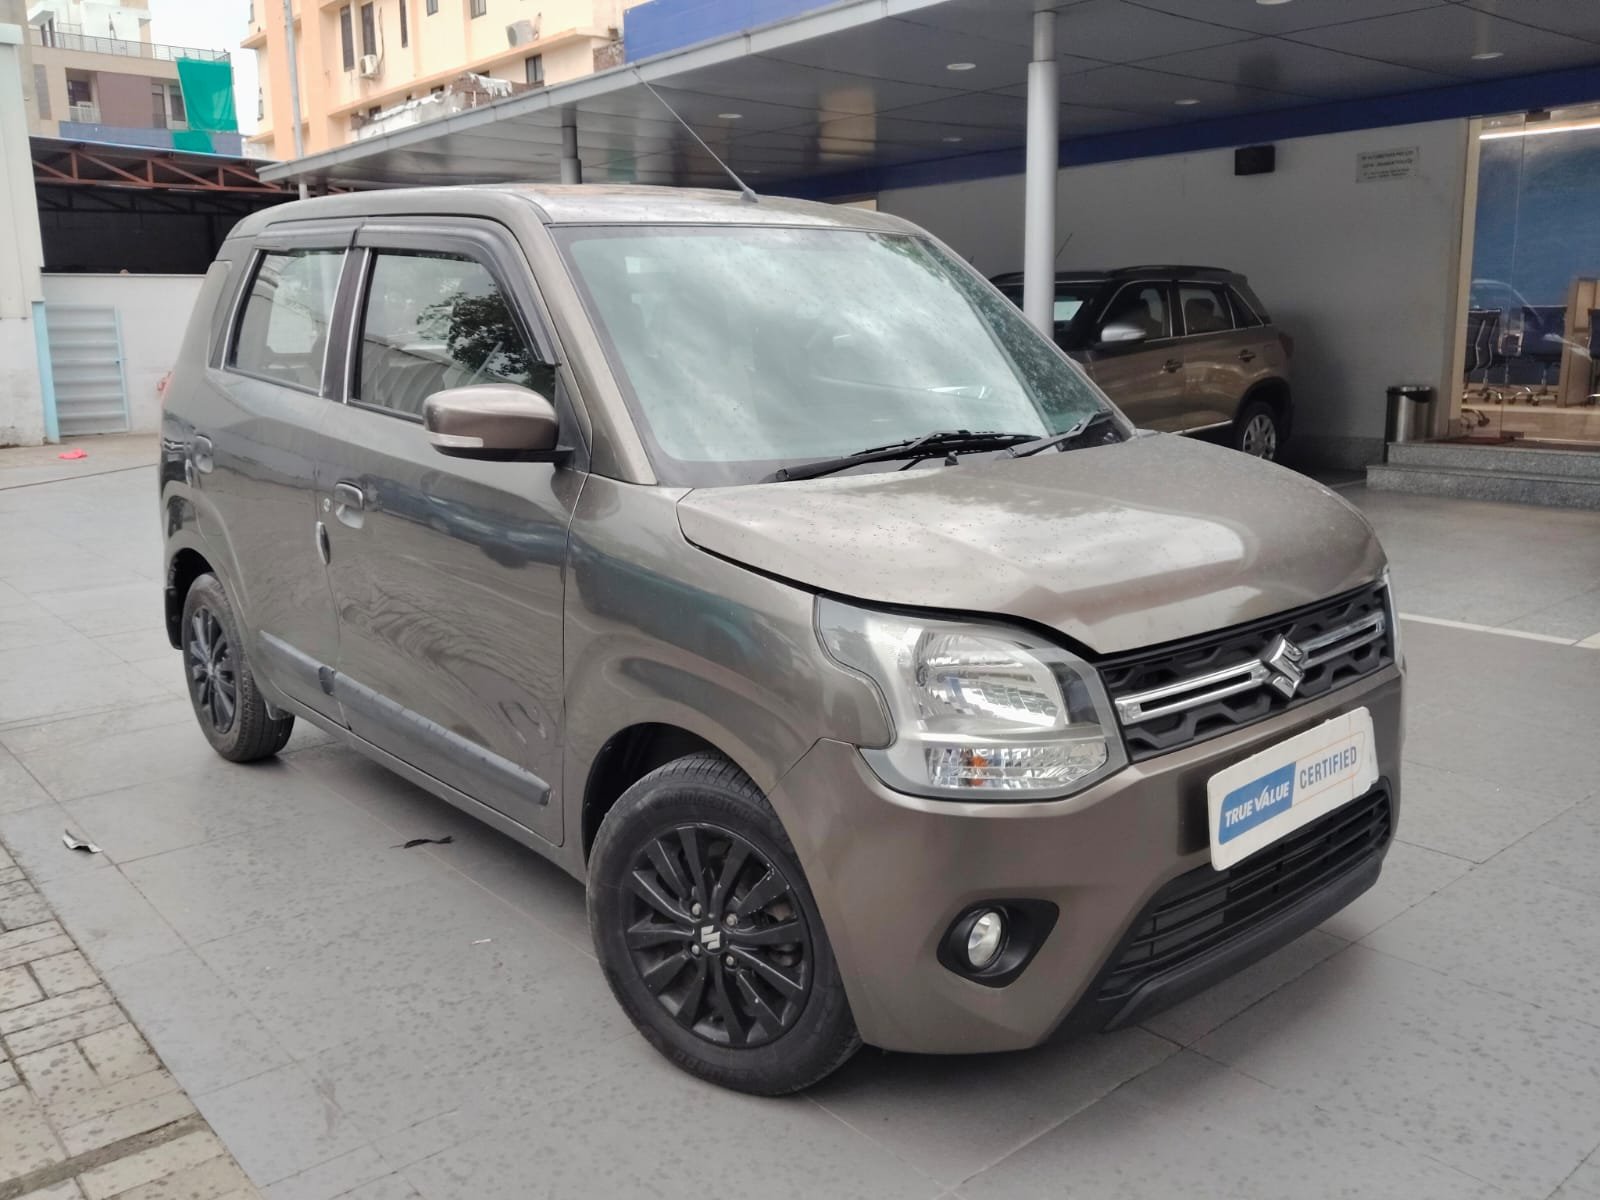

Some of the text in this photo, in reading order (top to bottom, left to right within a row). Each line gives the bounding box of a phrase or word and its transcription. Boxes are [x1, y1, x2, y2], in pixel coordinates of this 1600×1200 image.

[1224, 746, 1358, 828] TRUE VALUE CERTIFIED
